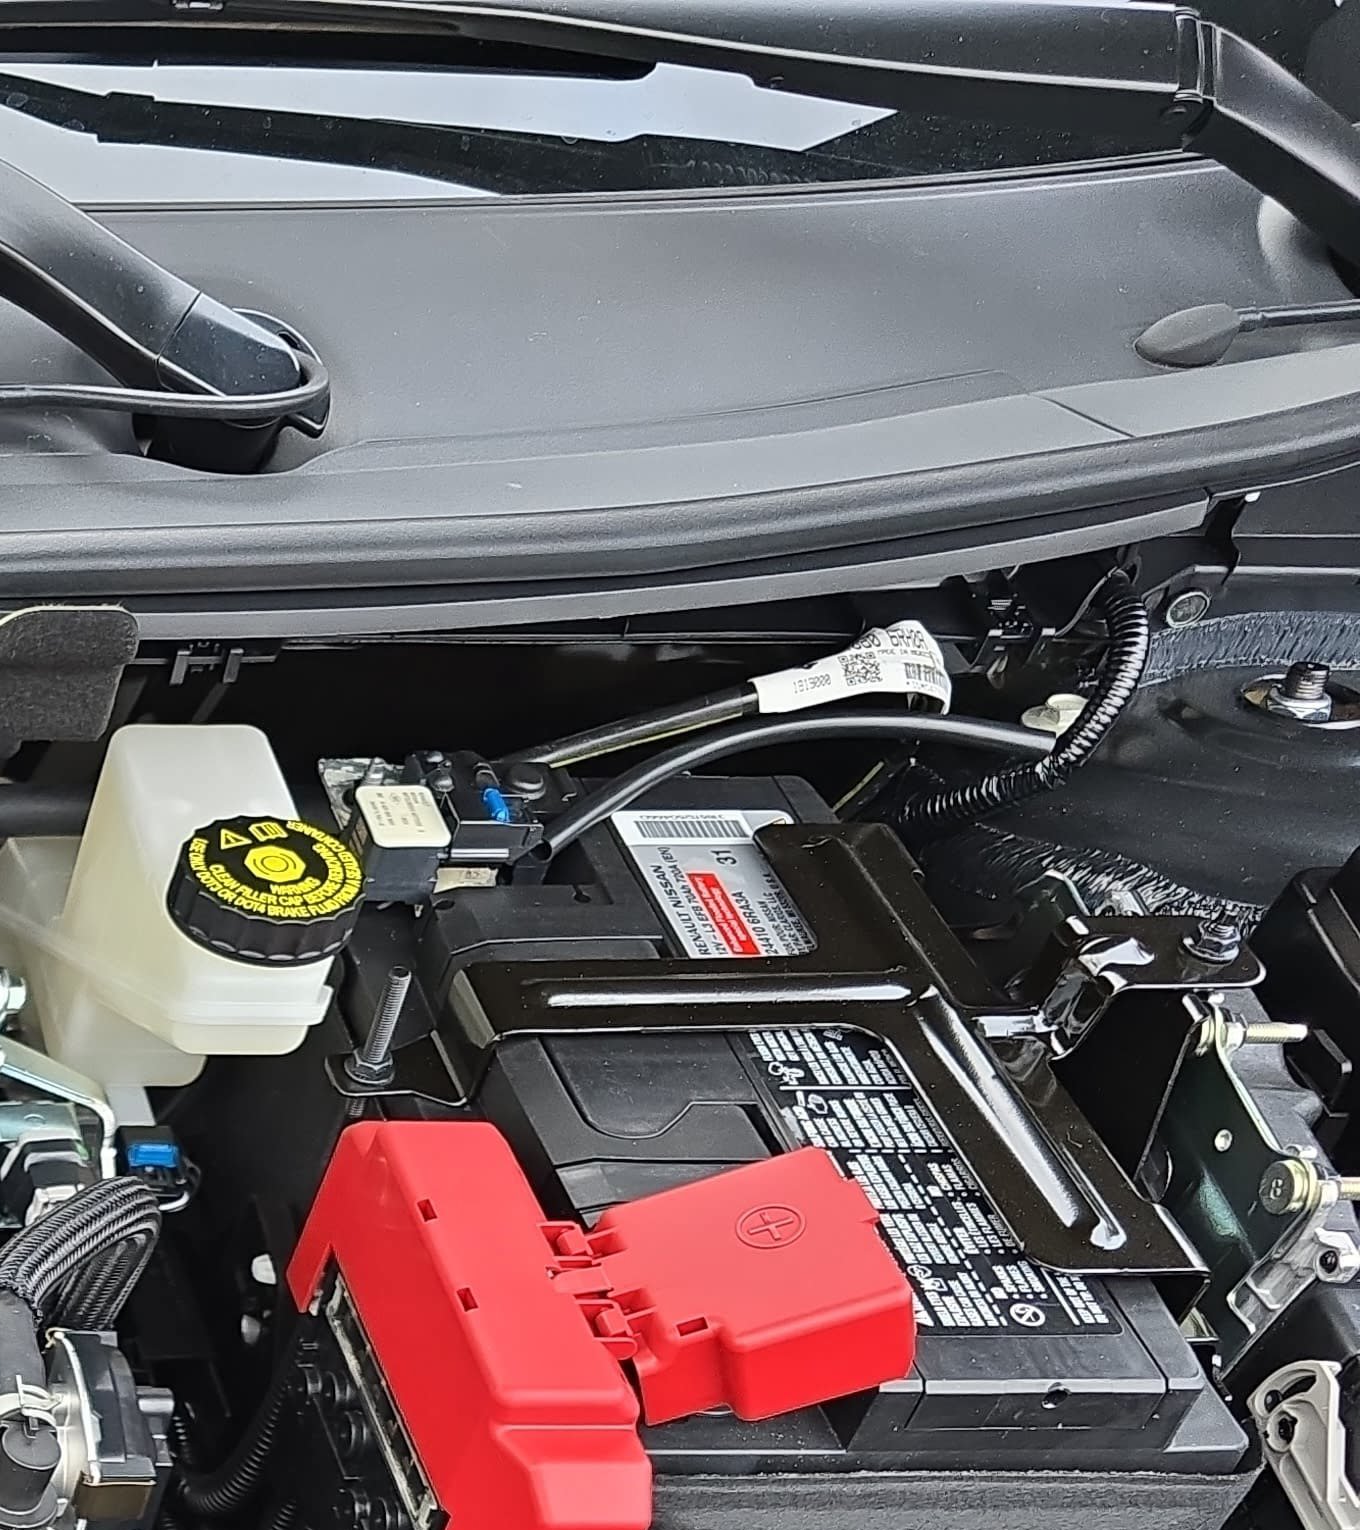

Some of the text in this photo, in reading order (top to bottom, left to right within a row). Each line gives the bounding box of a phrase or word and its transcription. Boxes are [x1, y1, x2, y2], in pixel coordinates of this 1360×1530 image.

[286, 820, 346, 853] CONTAINER
[657, 847, 678, 862] (EN)
[710, 849, 739, 864] 31
[196, 870, 221, 892] DOT3
[209, 843, 345, 906] CLEAN FILLER CAP BEFORE REMOVING
[270, 876, 321, 895] WARNING
[217, 889, 235, 903] OR
[649, 865, 686, 907] NISSAN
[234, 898, 266, 914] DOT4
[267, 905, 312, 918] BRAKE
[307, 899, 341, 916] FLUID
[691, 906, 708, 920] EFB
[675, 911, 713, 954] RENAULT
[730, 891, 780, 954] 24410 6RA3A
[940, 1163, 967, 1189] FLAMAS
[991, 1264, 1019, 1292] SPARKS
[1005, 1264, 1034, 1292] FLAMES
